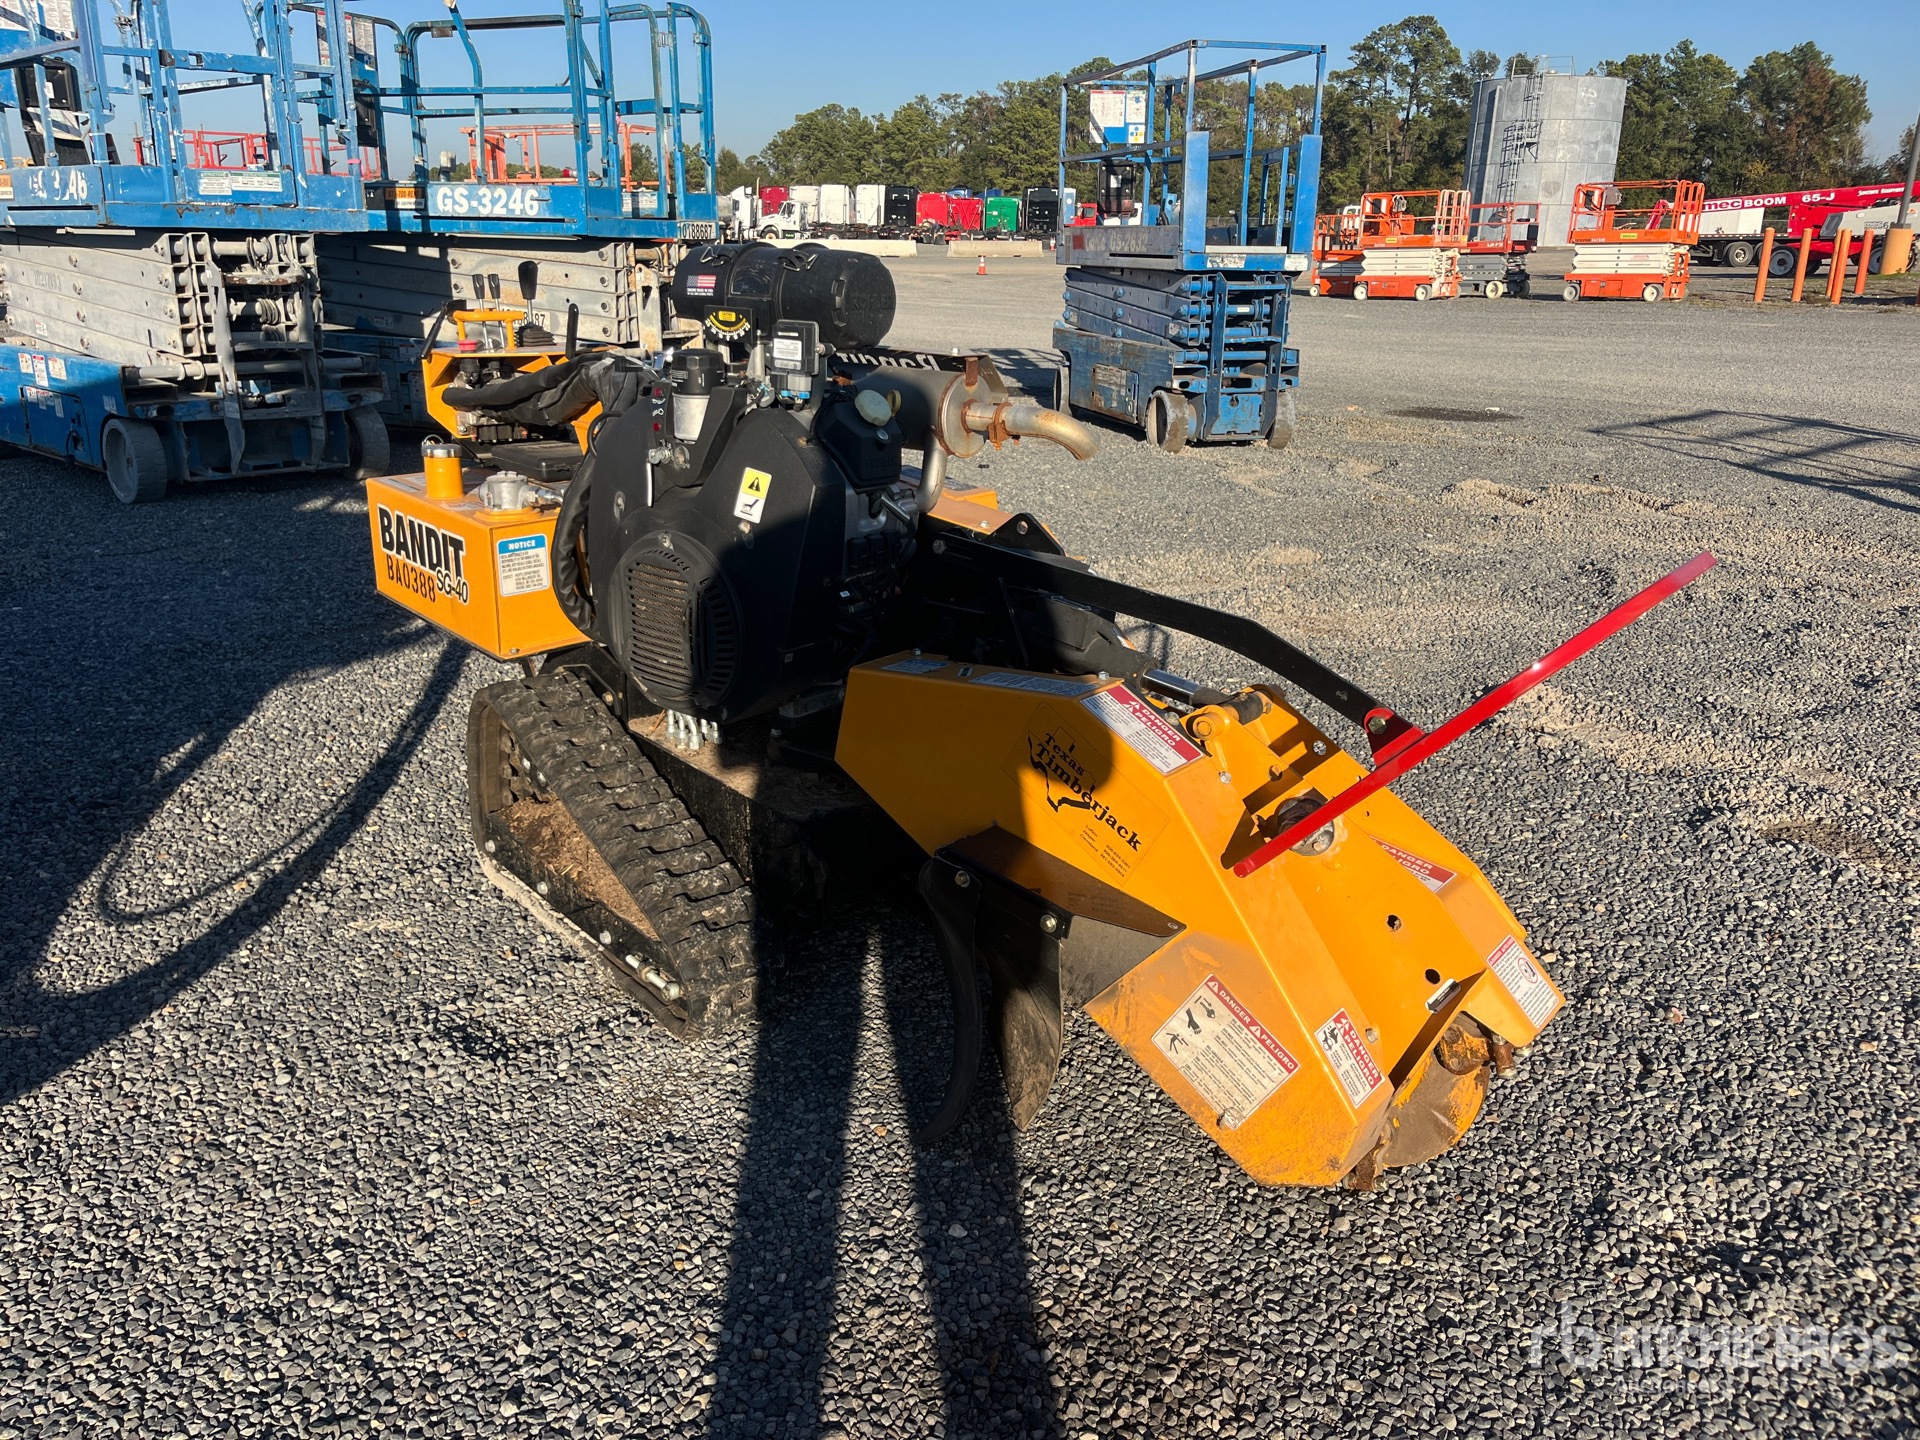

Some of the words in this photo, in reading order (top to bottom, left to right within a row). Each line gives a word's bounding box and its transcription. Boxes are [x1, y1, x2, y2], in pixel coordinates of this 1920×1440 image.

[437, 186, 540, 216] GS-3246
[1743, 196, 1787, 207] BOOM
[1801, 192, 1836, 203] 65-J
[378, 505, 465, 582] BANDIT
[508, 540, 536, 550] NOTICE
[386, 553, 436, 604] BA0388
[436, 567, 469, 605] SG-40
[1135, 712, 1176, 746] PELIGRO
[1142, 709, 1181, 741] DANGER
[1045, 732, 1085, 776] Texas
[1036, 743, 1142, 852] Timberjack
[1381, 844, 1433, 870] DANGER
[1218, 990, 1251, 1024] DANGER
[1260, 1034, 1295, 1070] PELIGRO
[1344, 1034, 1375, 1085] PELIGRO
[1350, 1029, 1379, 1078] DANGER
